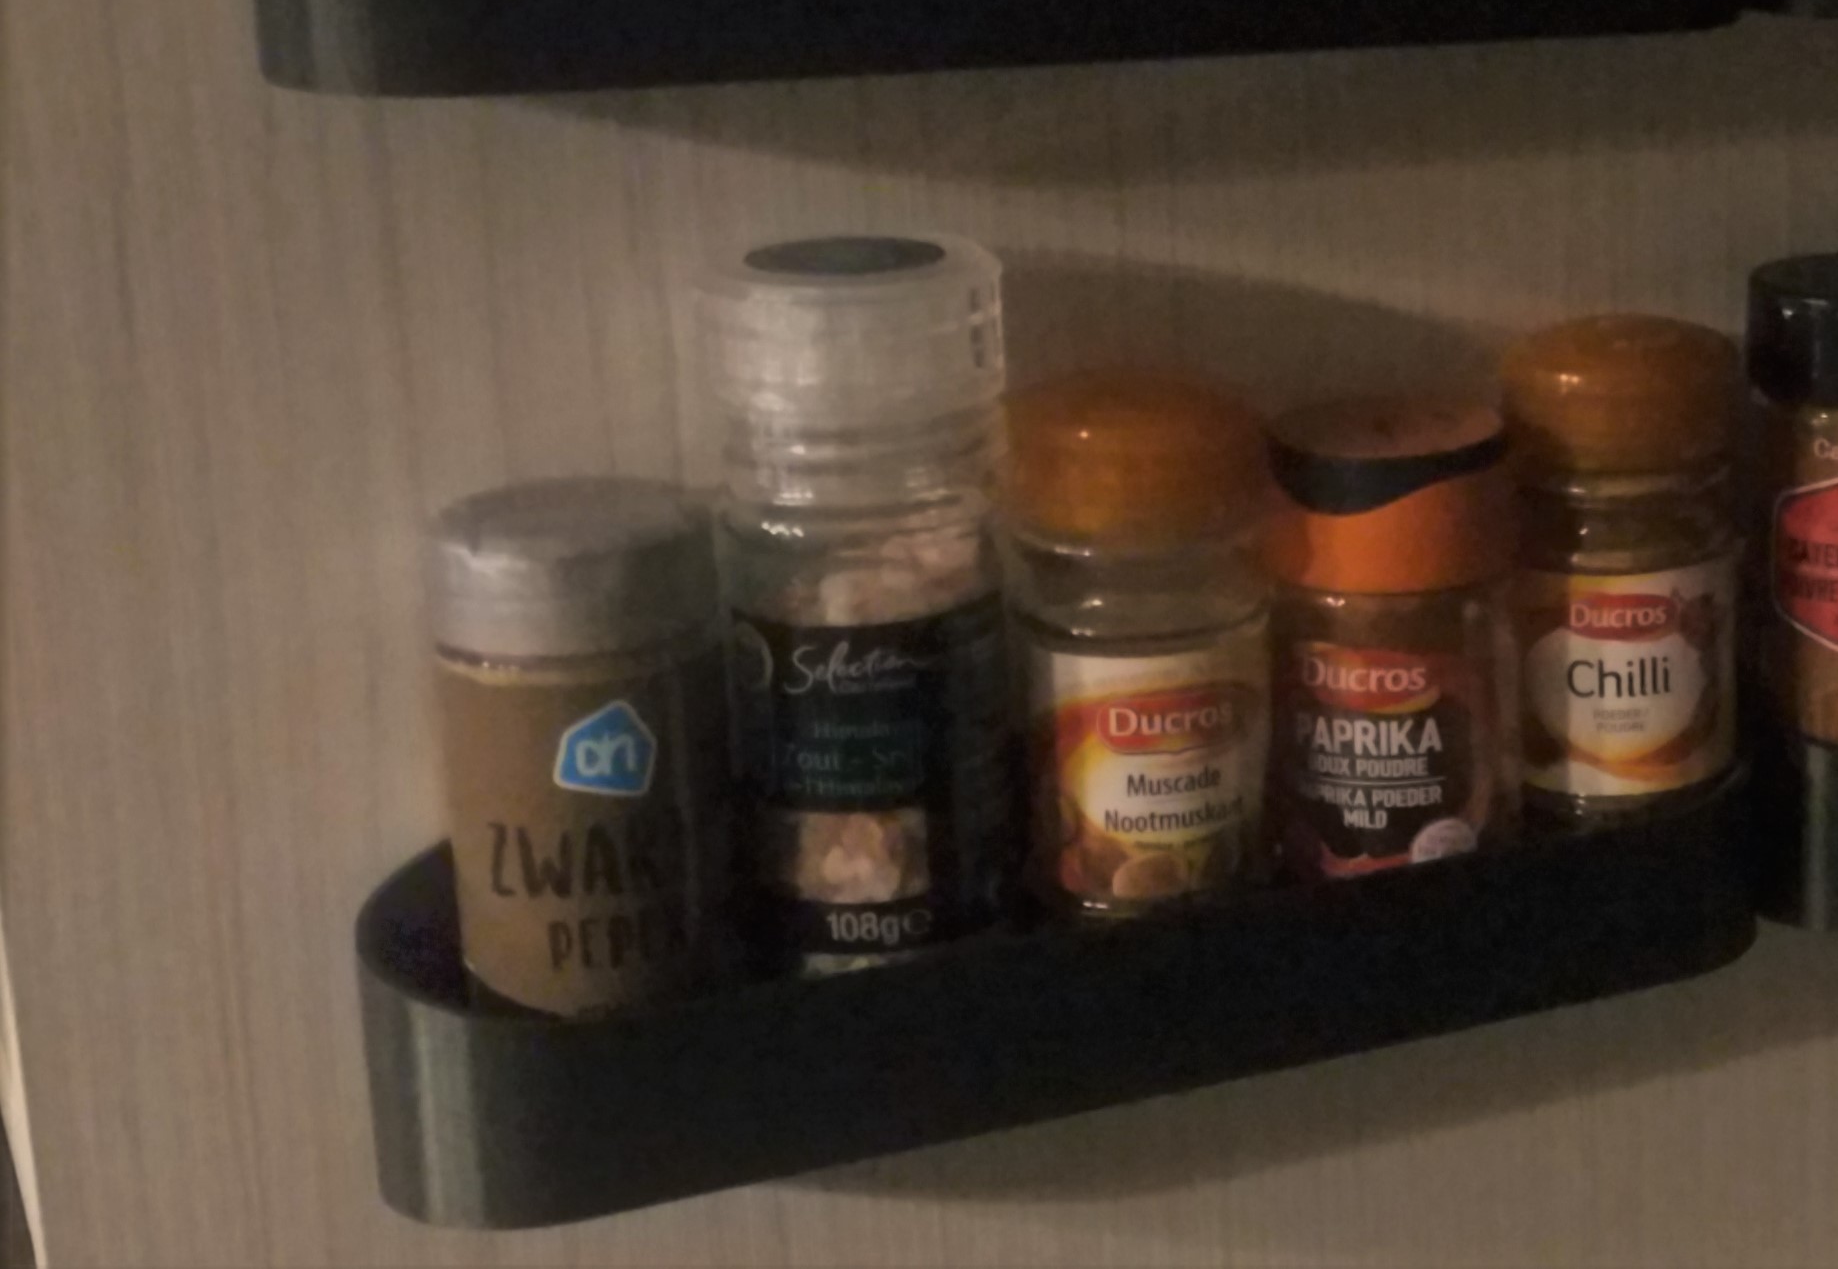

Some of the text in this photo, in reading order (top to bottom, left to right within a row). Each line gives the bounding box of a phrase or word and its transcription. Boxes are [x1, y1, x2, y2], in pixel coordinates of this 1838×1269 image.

[1570, 601, 1667, 630] Ducros
[1302, 656, 1426, 693] Ducros
[1567, 657, 1671, 698] Chilli
[1109, 702, 1233, 737] Ducros
[1296, 713, 1442, 757] PAPRIKA
[1127, 765, 1221, 797] Muscade
[1356, 756, 1430, 778] POUDRE
[1299, 778, 1442, 808] PRIKA POEDER
[1343, 808, 1388, 830] MILD
[487, 805, 684, 899] ZWAR
[548, 899, 688, 972] PEP
